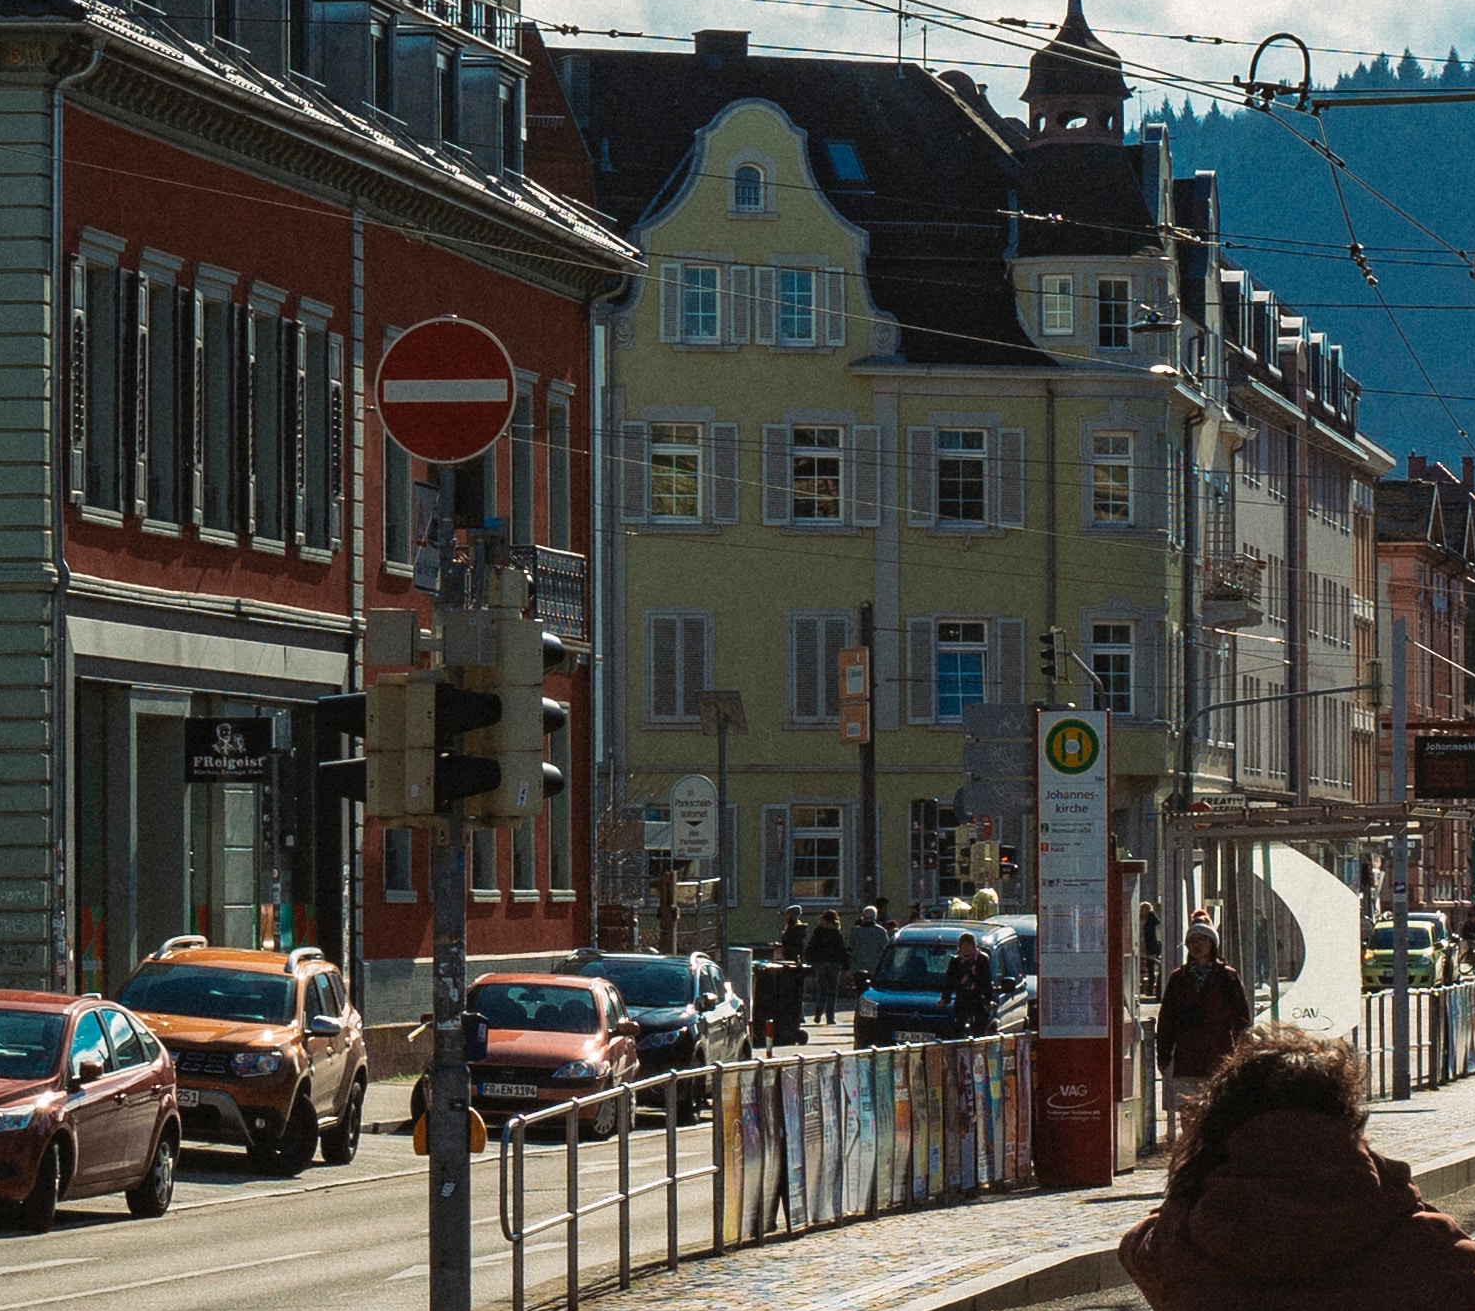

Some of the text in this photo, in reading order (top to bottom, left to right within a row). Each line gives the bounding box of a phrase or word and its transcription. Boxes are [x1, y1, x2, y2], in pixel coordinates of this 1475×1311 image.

[193, 756, 267, 770] FReigeist
[1045, 790, 1098, 801] Johannes-
[1055, 803, 1088, 813] kirche
[484, 1085, 536, 1095] FR EN 1194
[1060, 1084, 1088, 1097] VAG
[176, 1091, 198, 1103] 251
